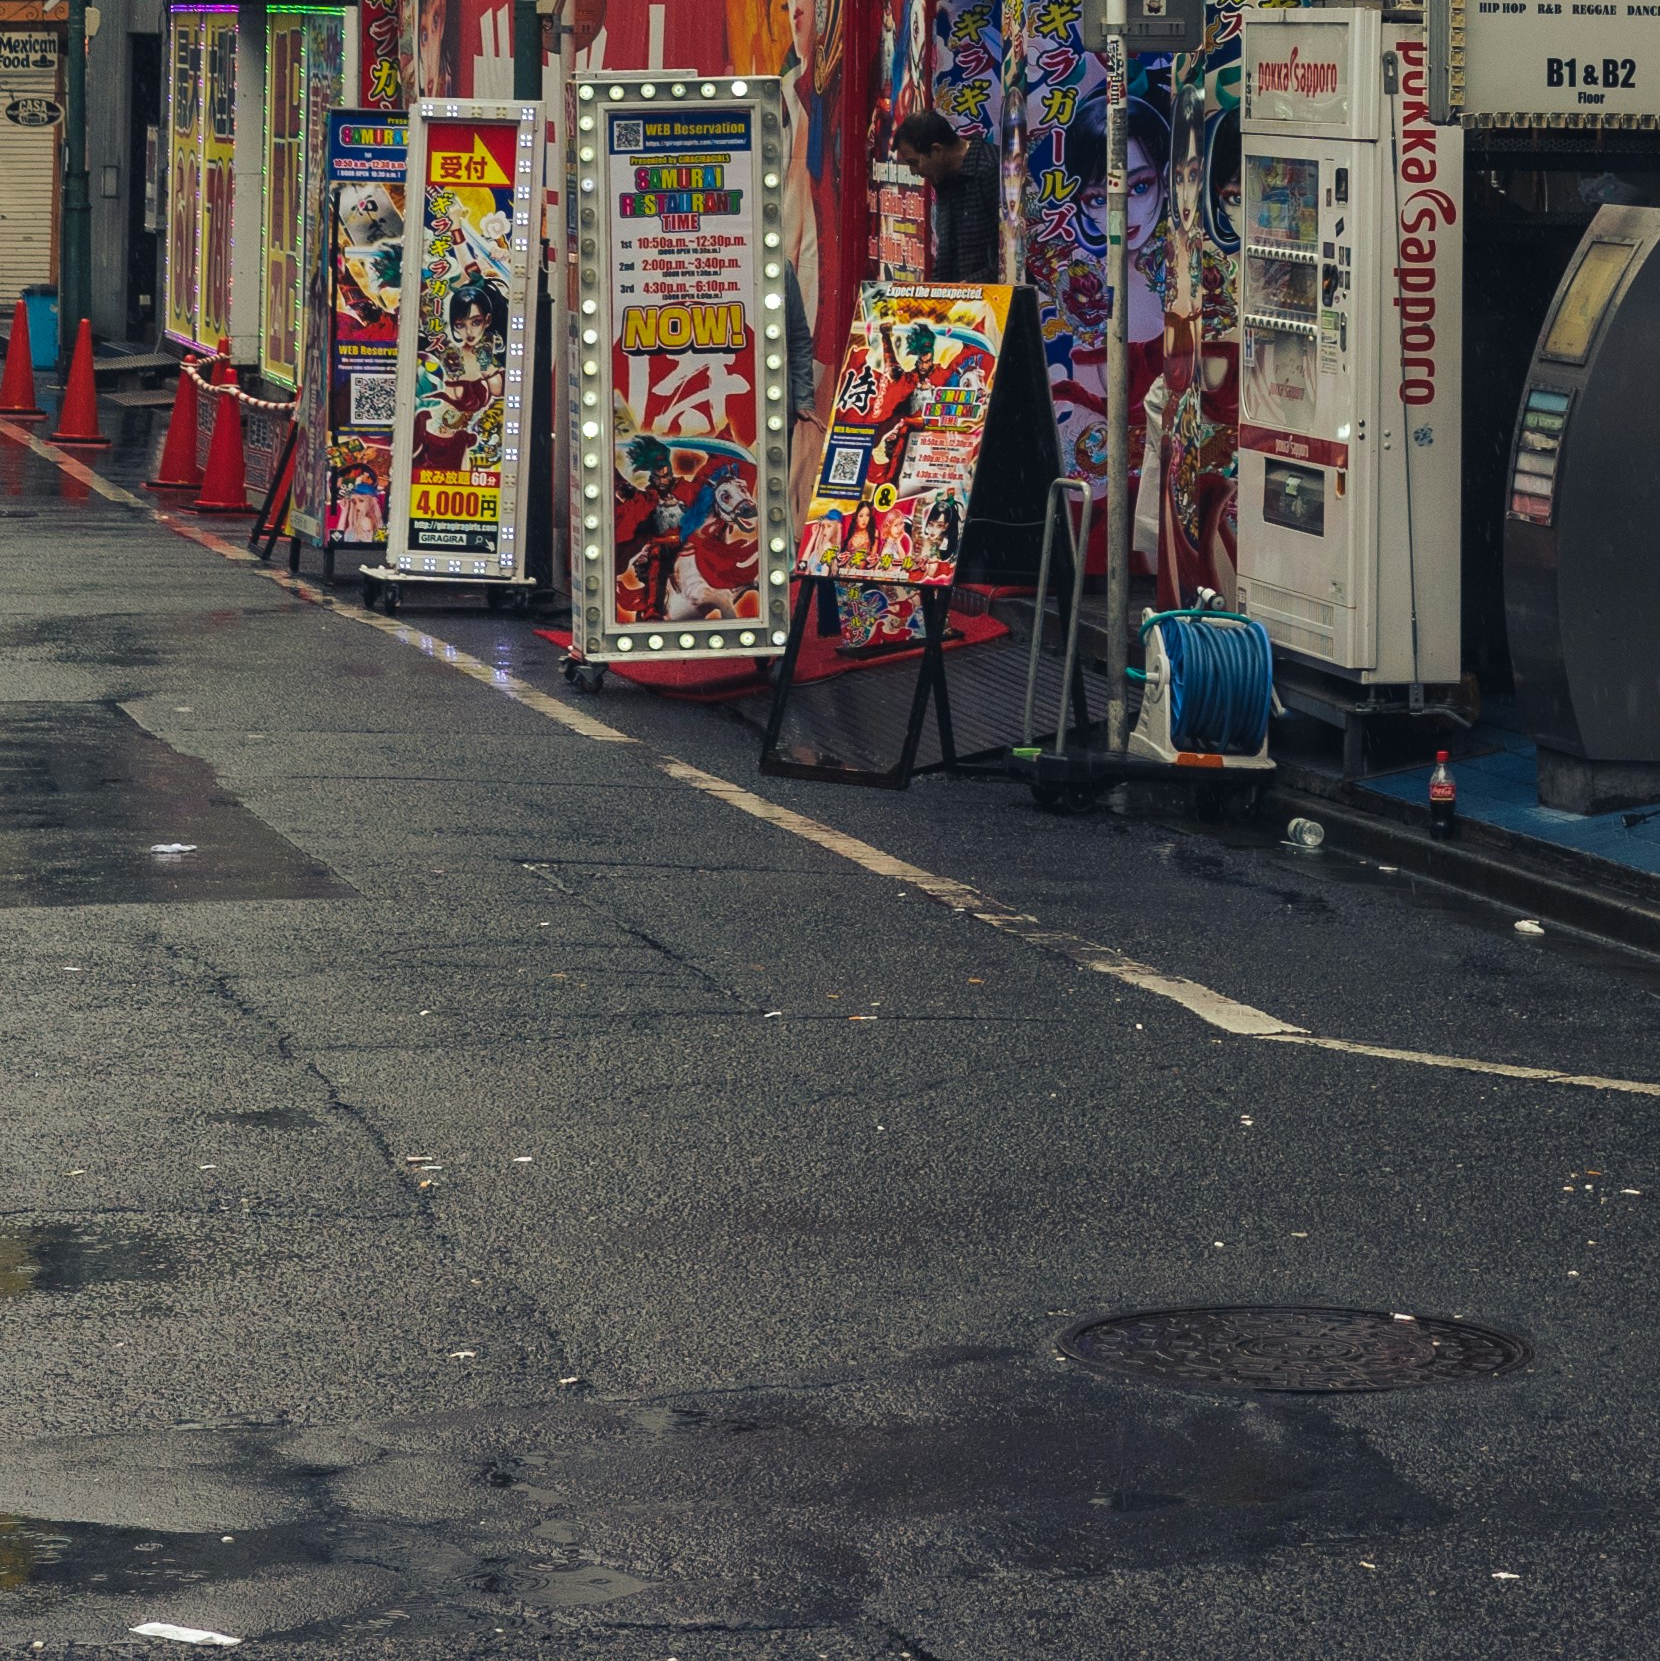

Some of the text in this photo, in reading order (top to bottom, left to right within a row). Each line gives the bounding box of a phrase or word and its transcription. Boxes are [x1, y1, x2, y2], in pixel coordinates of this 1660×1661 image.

[1479, 2, 1500, 14] HIP
[1502, 2, 1527, 14] HOP
[1537, 3, 1562, 15] R&B
[1572, 4, 1617, 16] REGGAE
[0, 35, 57, 54] Mexican
[1258, 61, 1289, 97] pokka
[1546, 57, 1636, 89] B1 & B2
[1577, 91, 1605, 104] Floor
[19, 100, 48, 115] CASA
[645, 122, 745, 136] WEB Reservation
[440, 155, 488, 180] 受付
[631, 155, 667, 165] Presented
[668, 155, 677, 165] by
[635, 166, 723, 191] SAMURAI
[620, 190, 742, 217] RESTAURANT
[661, 213, 699, 231] TIME
[621, 240, 632, 249] 1st
[427, 191, 455, 354] ギラギラガールズ
[619, 262, 635, 272] 2nd
[620, 284, 635, 294] 3rd
[886, 284, 915, 298] Expect
[915, 286, 930, 298] the
[622, 302, 747, 350] NOW!
[836, 365, 879, 416] 侍
[934, 388, 977, 403] SAMURAI
[416, 490, 497, 518] 4,000円
[420, 534, 465, 544] GIRAGIRA
[820, 546, 930, 572] ギラギラガールズ
